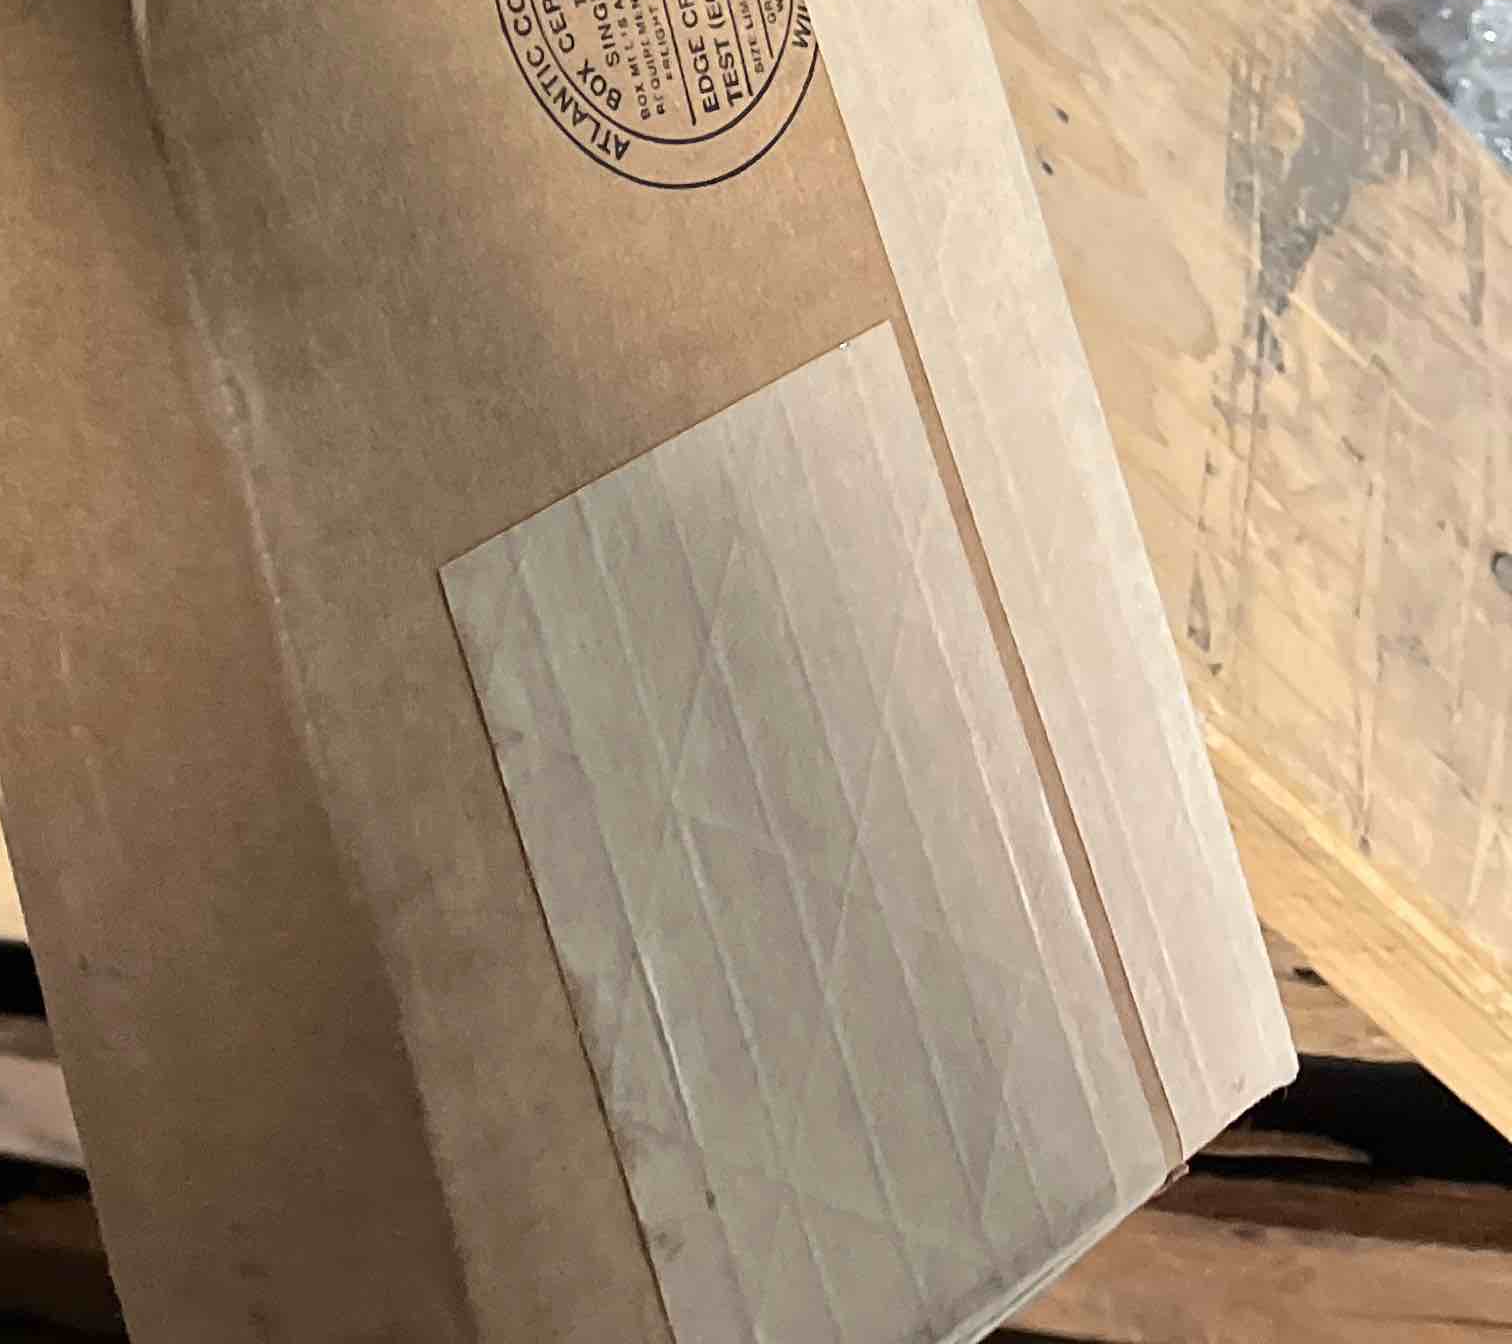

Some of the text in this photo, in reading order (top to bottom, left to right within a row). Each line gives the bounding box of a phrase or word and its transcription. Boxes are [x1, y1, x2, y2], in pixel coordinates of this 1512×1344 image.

[526, 45, 631, 161] ATLANTIC
[576, 58, 622, 111] BOX
[688, 35, 720, 113] EDGE
[713, 37, 744, 107] TEST
